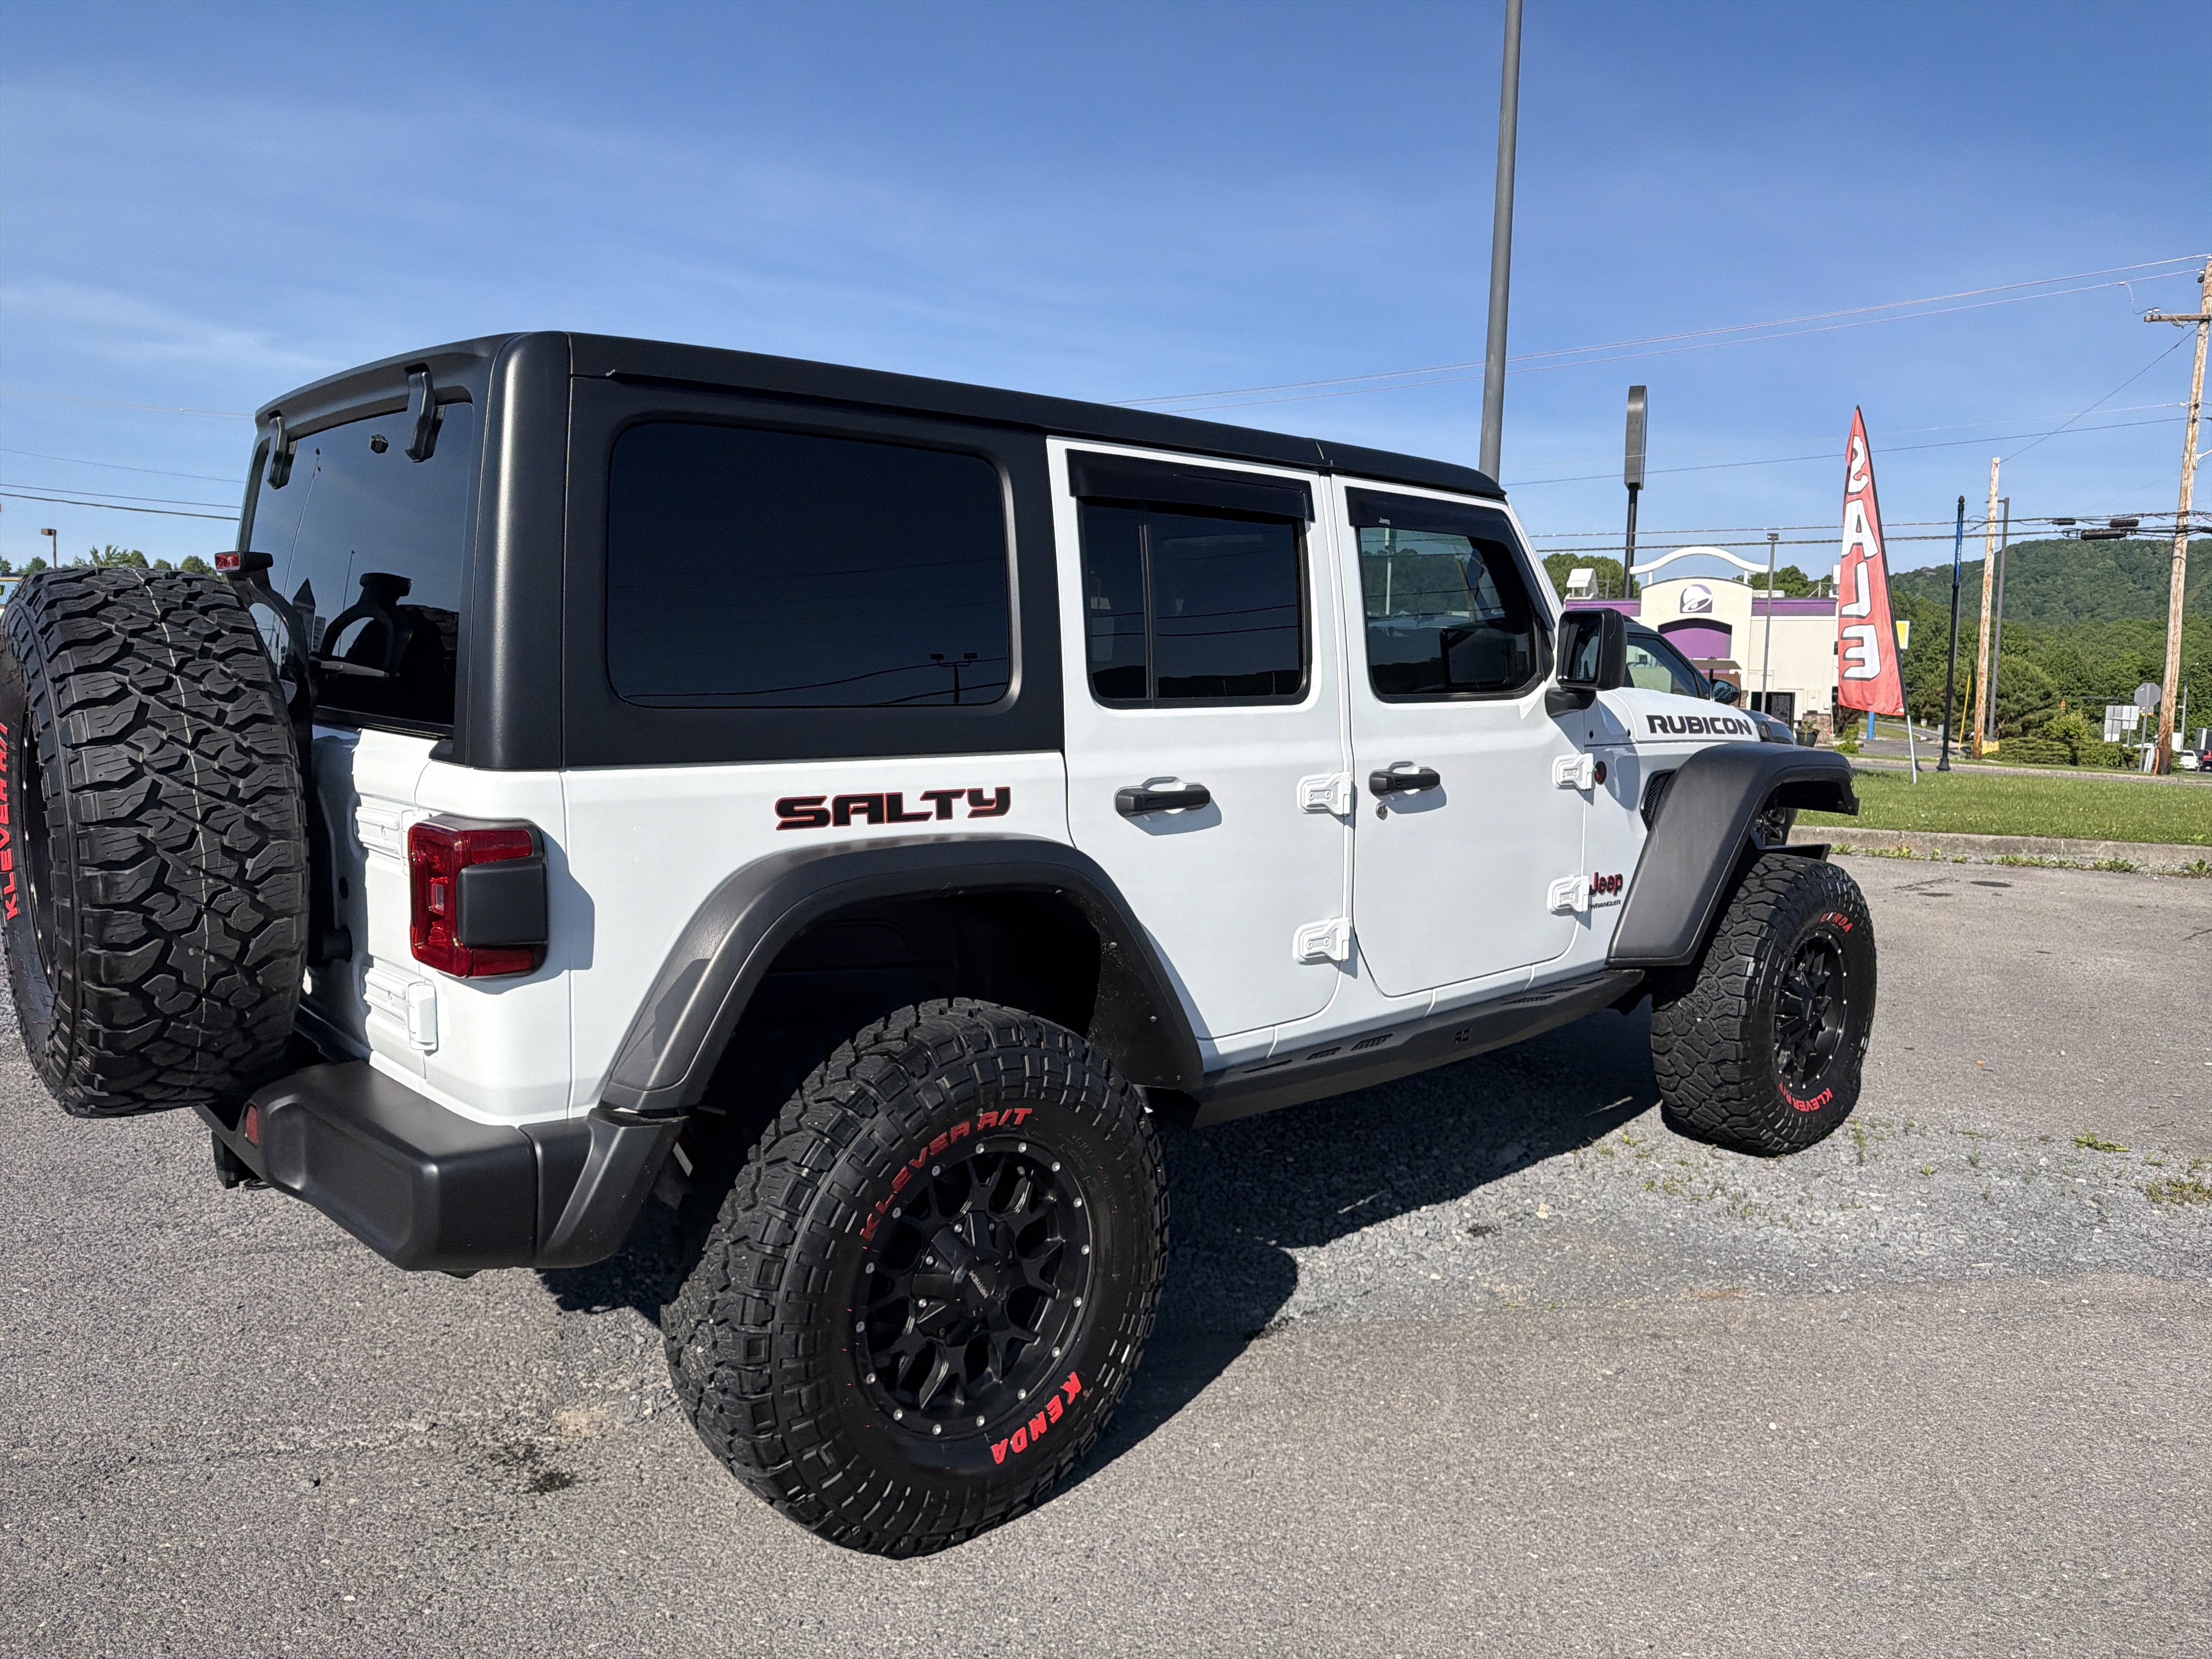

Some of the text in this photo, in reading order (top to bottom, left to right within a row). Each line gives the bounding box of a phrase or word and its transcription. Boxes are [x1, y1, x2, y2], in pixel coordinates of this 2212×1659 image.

[1378, 516, 1391, 526] Jeep
[1646, 714, 1753, 736] RUBICON
[775, 786, 1011, 831] SALTY
[1589, 871, 1623, 896] Jeep
[1590, 900, 1621, 909] WRANGLER
[1792, 1087, 1833, 1113] KLEVER
[859, 1108, 1033, 1242] KLEVER R/T
[990, 1370, 1082, 1465] KENDA
